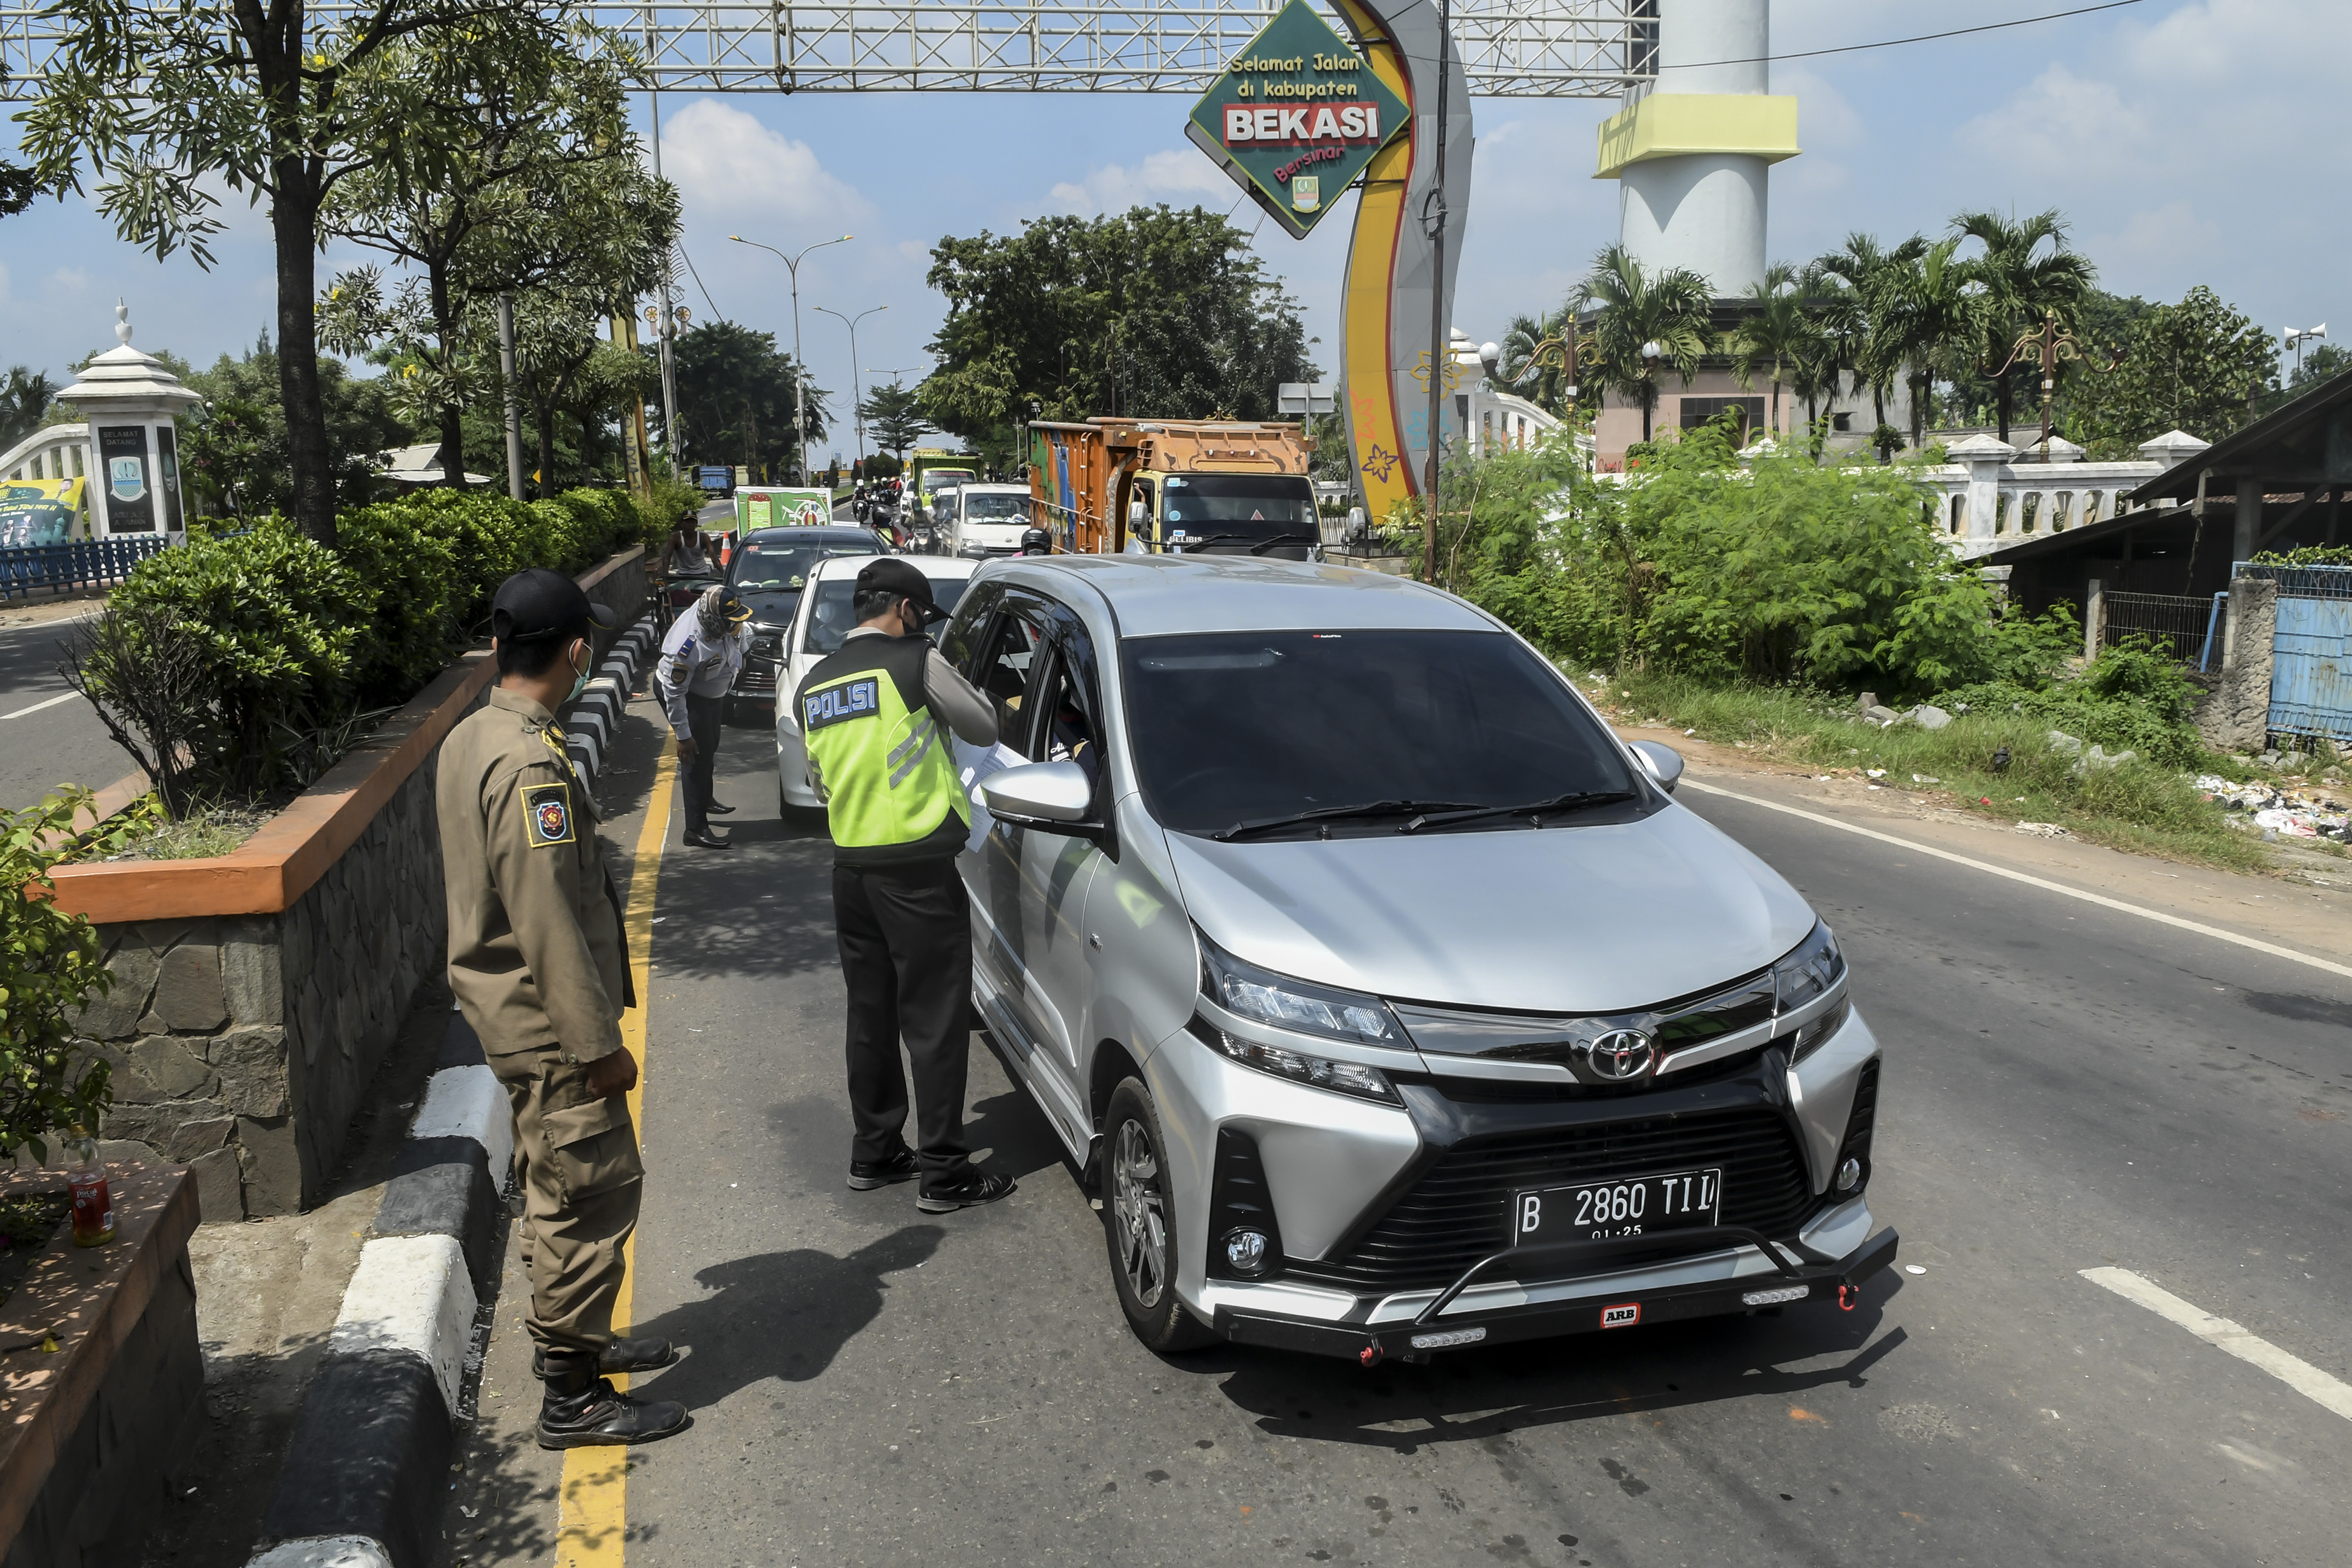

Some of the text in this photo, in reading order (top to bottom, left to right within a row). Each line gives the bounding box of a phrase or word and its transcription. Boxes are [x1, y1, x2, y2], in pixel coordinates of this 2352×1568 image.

[1230, 53, 1359, 72] Selamat Jalan
[1237, 81, 1254, 97] di
[1227, 106, 1379, 141] BEKASI
[1274, 146, 1345, 183] Bersinar
[806, 682, 876, 724] POLISI
[1522, 1196, 1541, 1232] B
[1574, 1183, 1647, 1226] 2860
[1605, 1309, 1635, 1322] ARB
